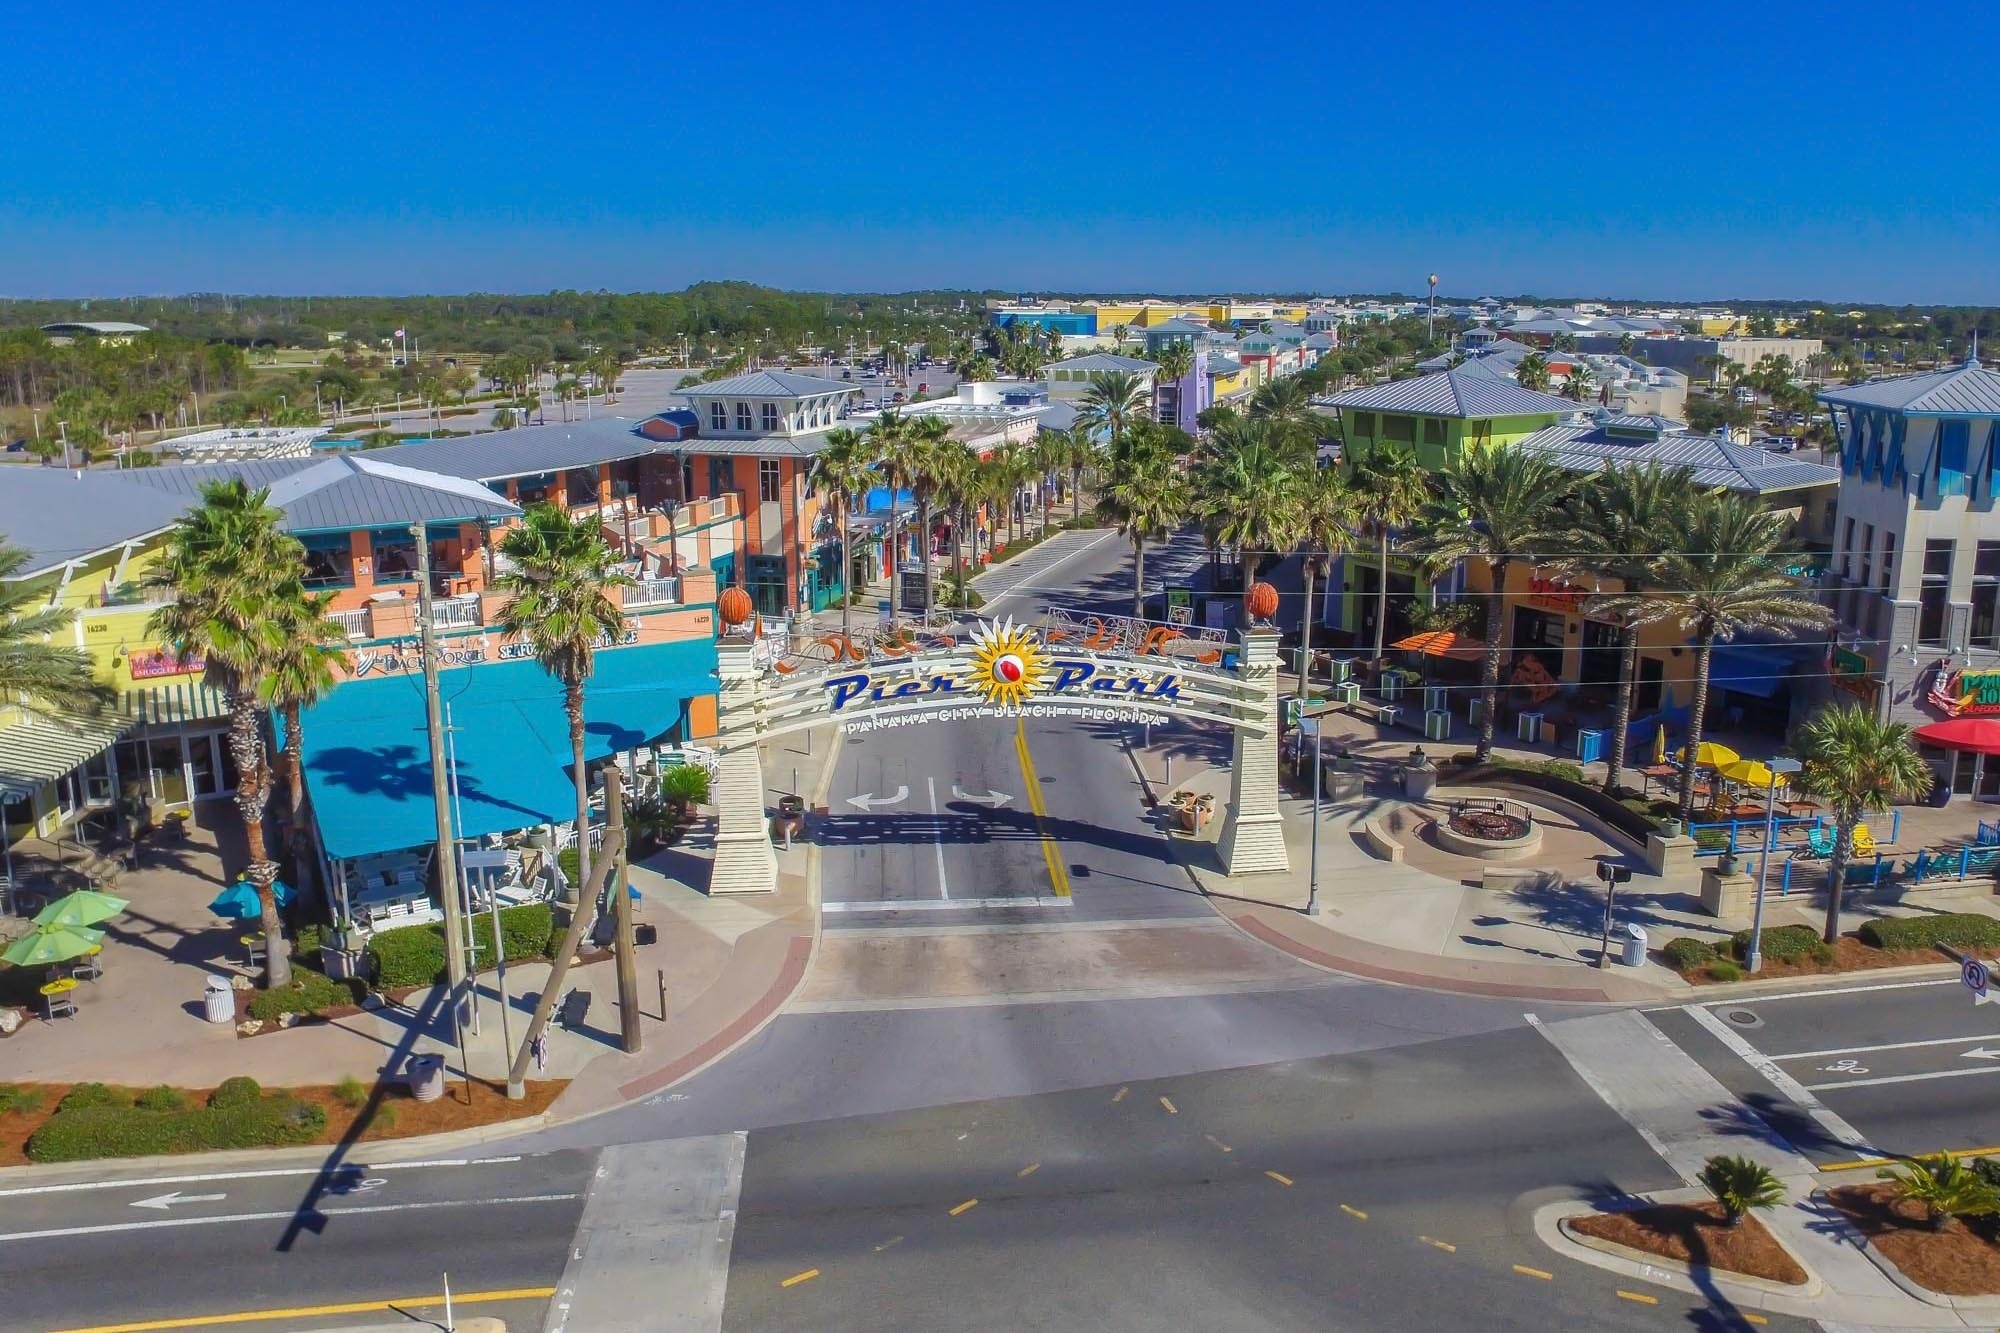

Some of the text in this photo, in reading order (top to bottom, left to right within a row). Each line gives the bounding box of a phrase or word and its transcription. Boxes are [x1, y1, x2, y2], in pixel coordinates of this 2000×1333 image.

[825, 660, 1194, 710] Pier Park
[1975, 689, 2000, 704] JO
[847, 705, 1162, 735] PANAMA CITY BEACH FLORIDA
